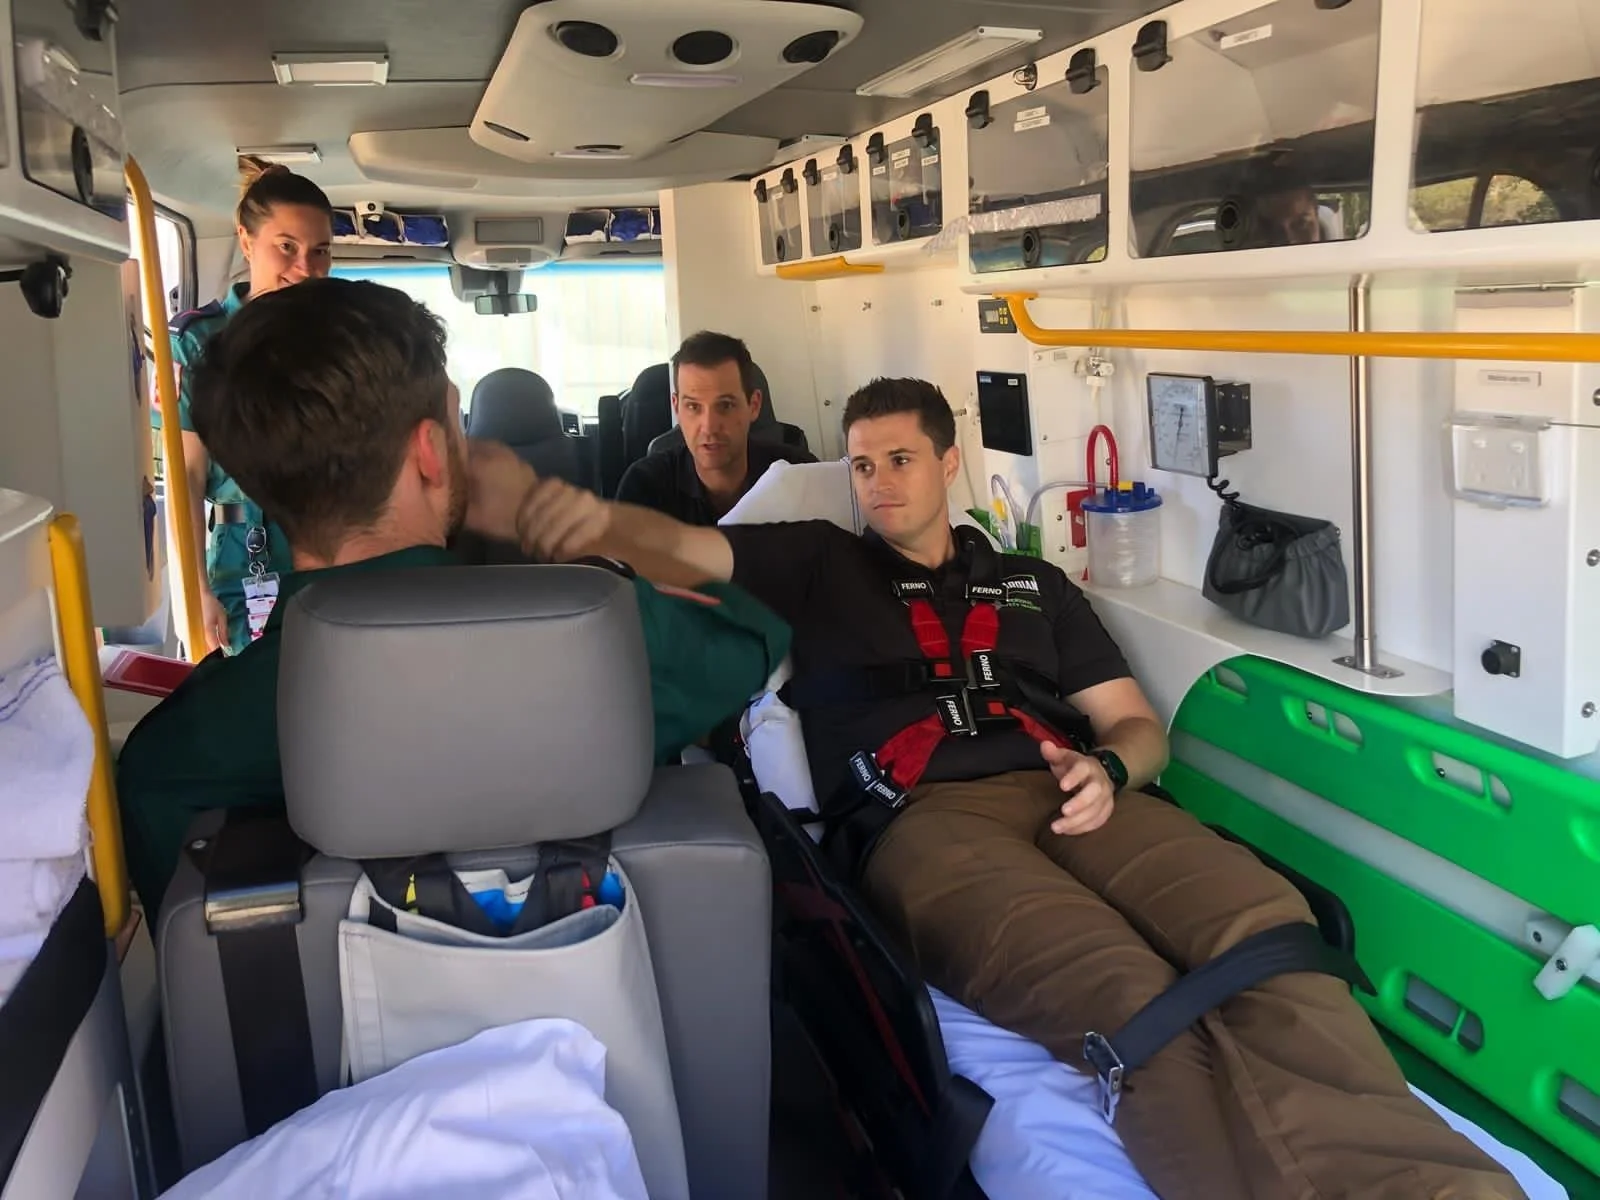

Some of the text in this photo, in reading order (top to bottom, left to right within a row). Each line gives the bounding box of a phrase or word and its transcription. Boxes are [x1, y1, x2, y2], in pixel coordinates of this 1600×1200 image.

[901, 582, 927, 590] FERNO
[972, 586, 1002, 595] FERNO
[979, 654, 994, 681] FERNO
[945, 700, 963, 726] FERNO
[855, 757, 872, 782] FERNO
[874, 783, 896, 800] FERNO
